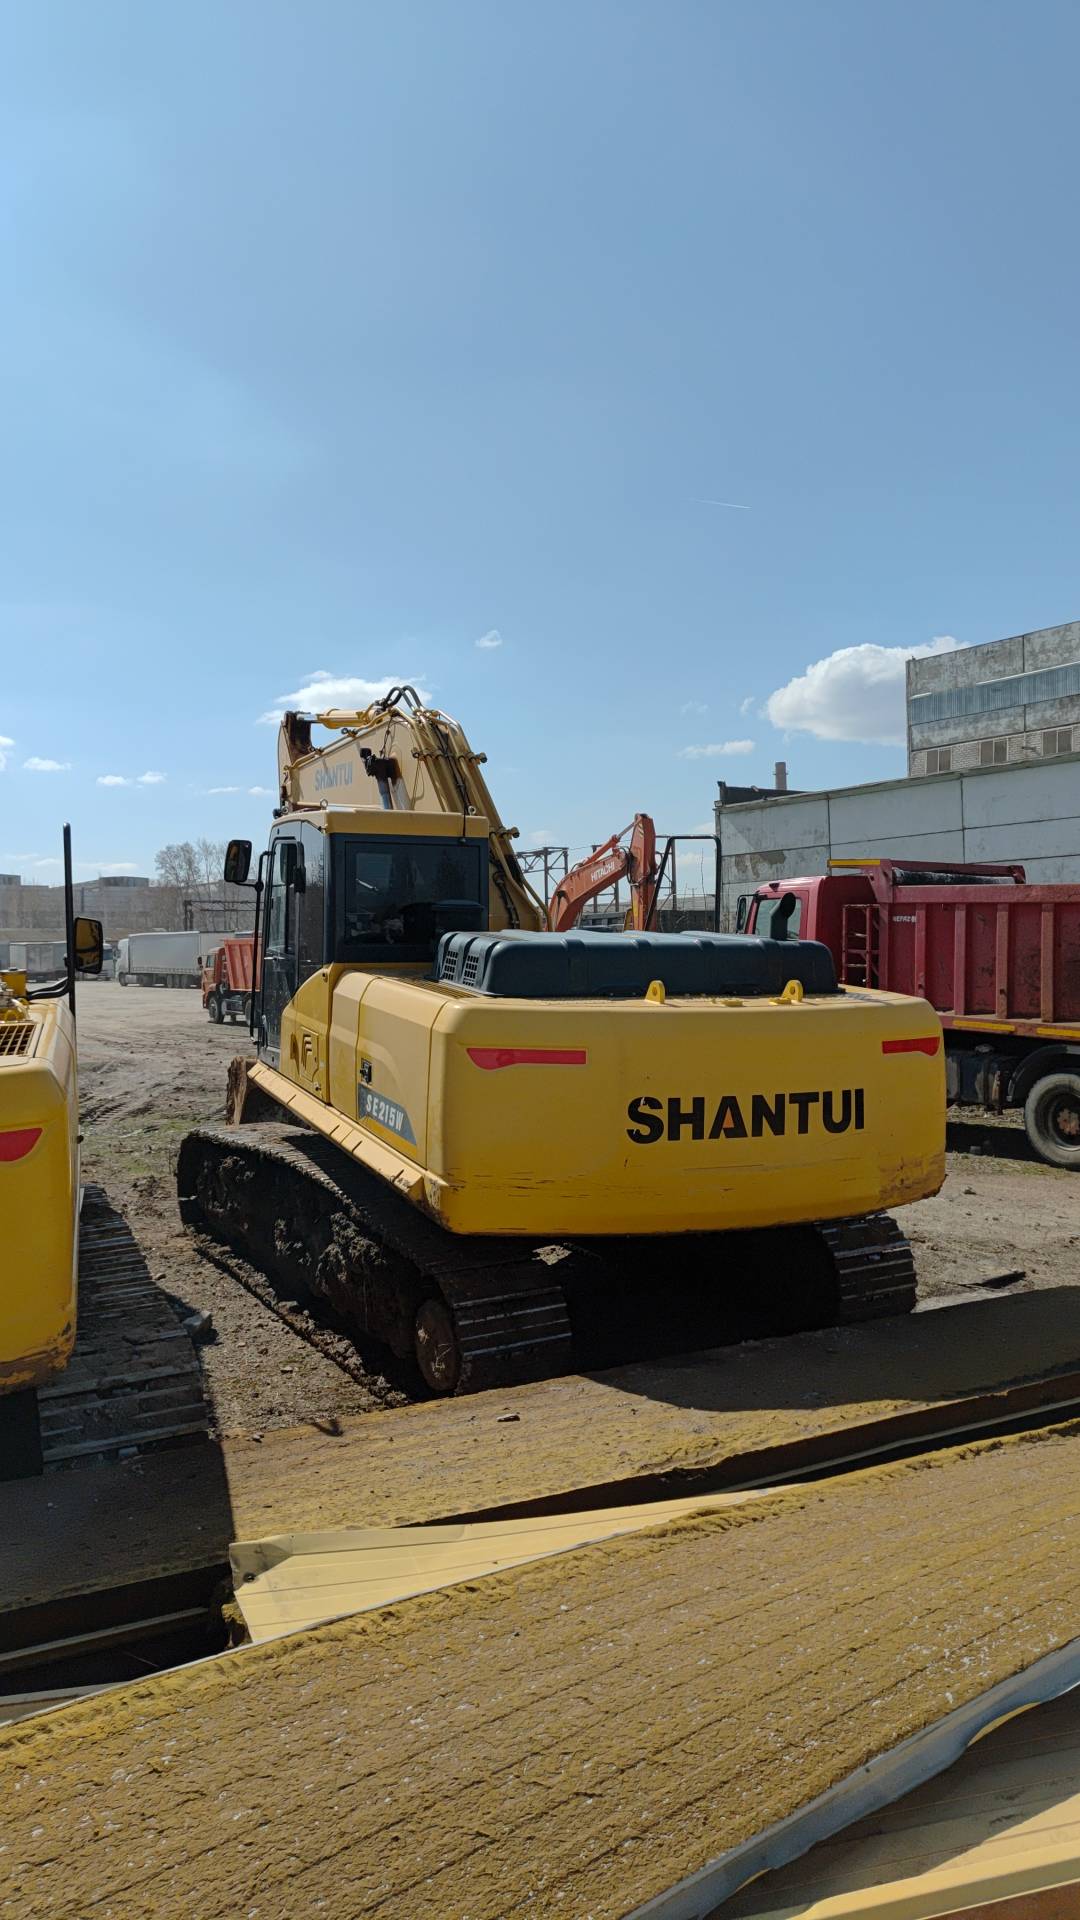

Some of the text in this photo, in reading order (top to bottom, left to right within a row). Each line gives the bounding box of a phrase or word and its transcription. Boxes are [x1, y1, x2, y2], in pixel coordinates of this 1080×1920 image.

[315, 762, 353, 791] SHANTUI
[591, 861, 615, 882] HITACHI
[366, 1094, 404, 1132] SE215W
[626, 1088, 865, 1145] SHANTUI
